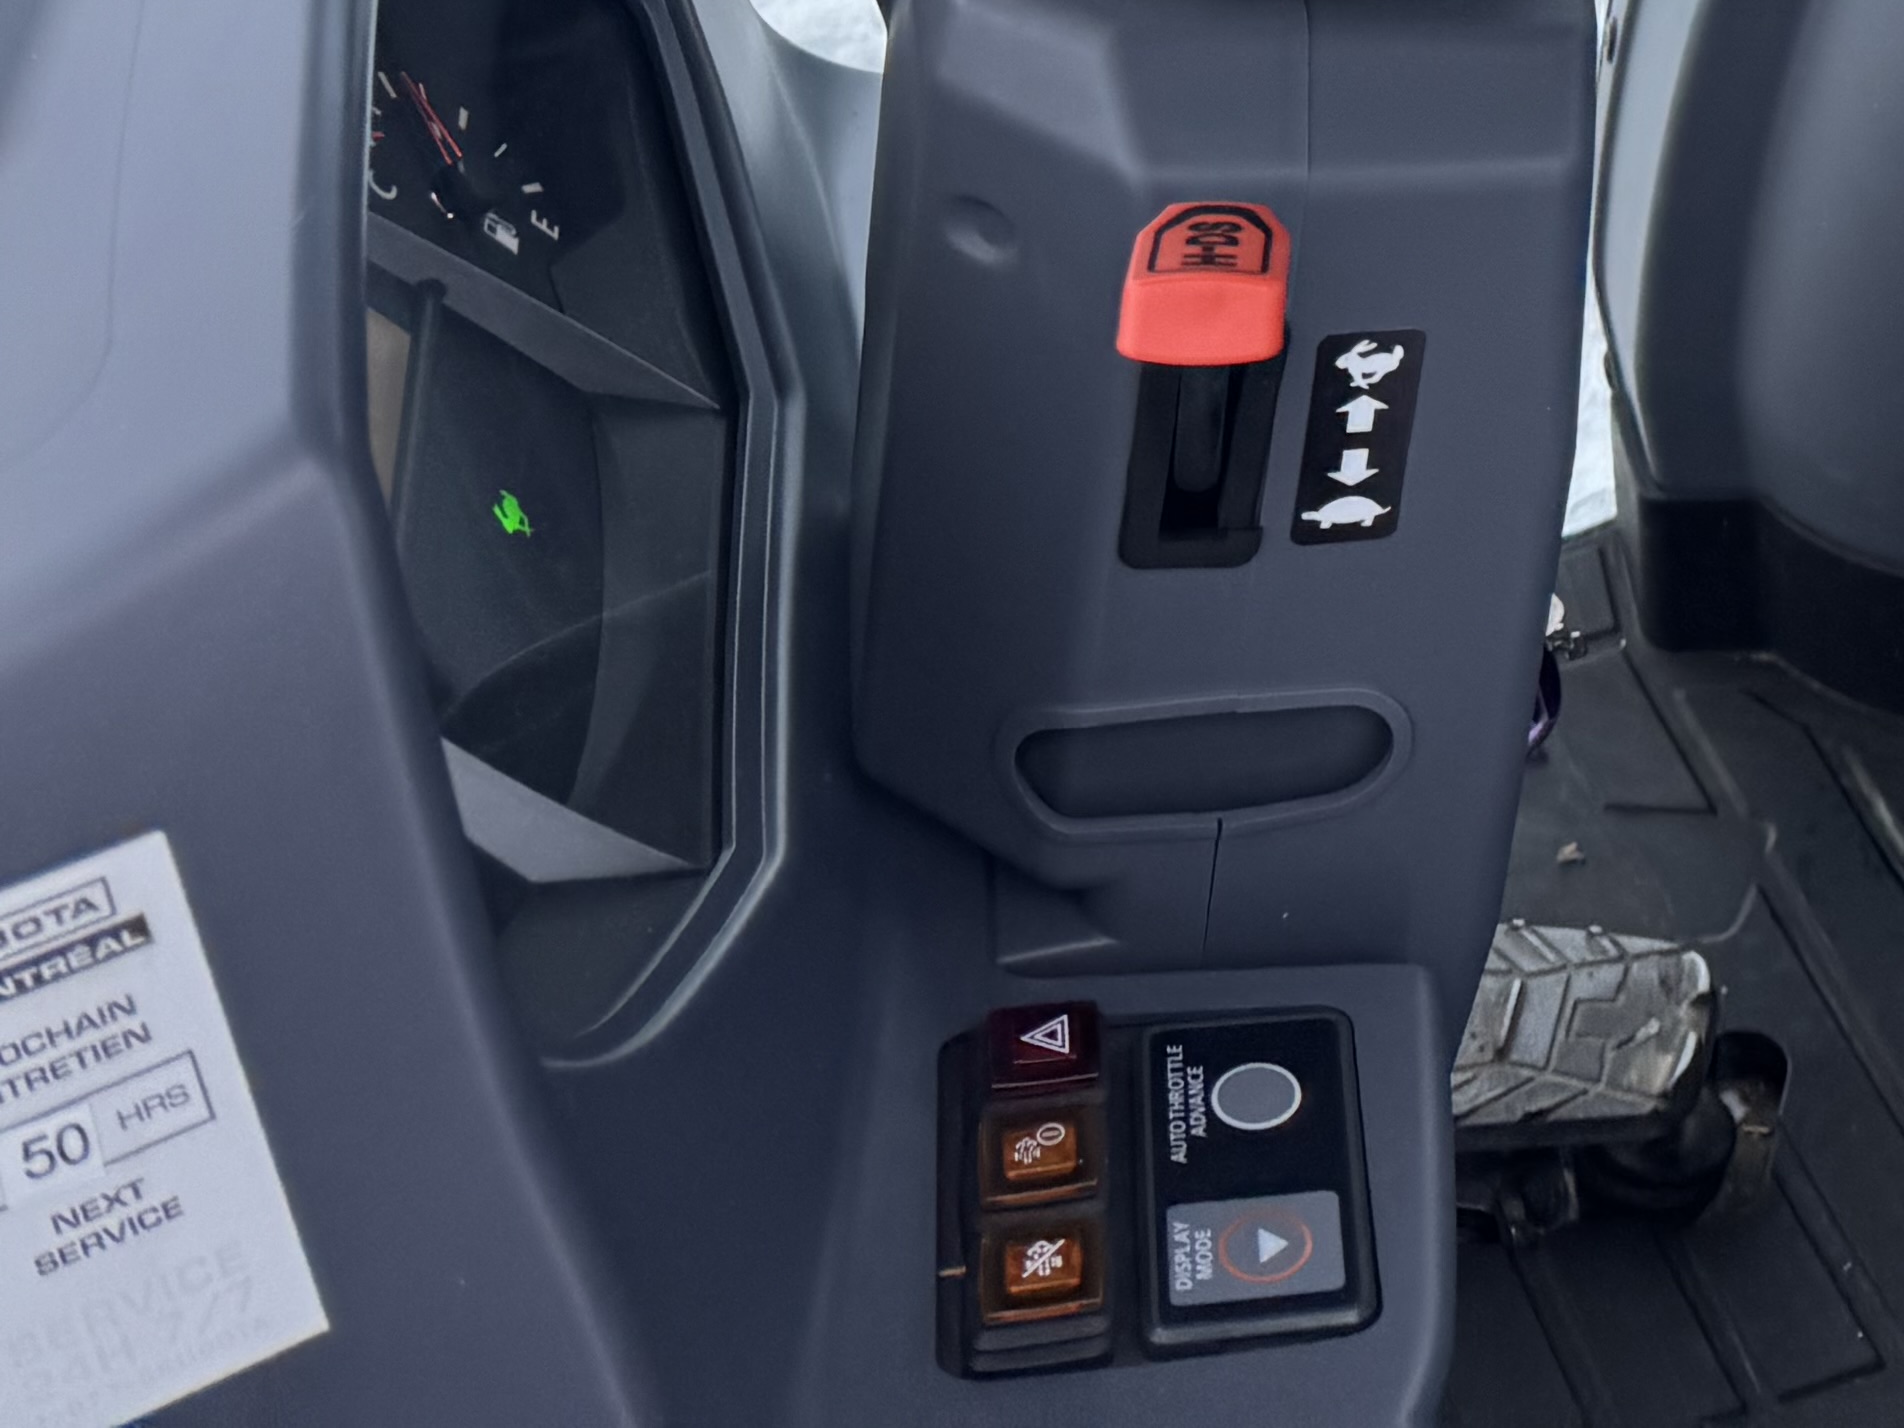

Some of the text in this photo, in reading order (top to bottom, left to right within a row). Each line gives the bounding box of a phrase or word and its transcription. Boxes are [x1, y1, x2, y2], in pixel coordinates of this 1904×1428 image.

[530, 209, 560, 242] E
[22, 1082, 192, 1182] 50 HRS
[1166, 1044, 1188, 1165] AUTO THROTTLE
[1186, 1065, 1208, 1138] ADVANCE
[34, 1194, 184, 1278] SERVICE
[51, 1177, 146, 1236] NEXT
[1172, 1221, 1193, 1291] DISPLAY
[1195, 1228, 1212, 1281] MODE
